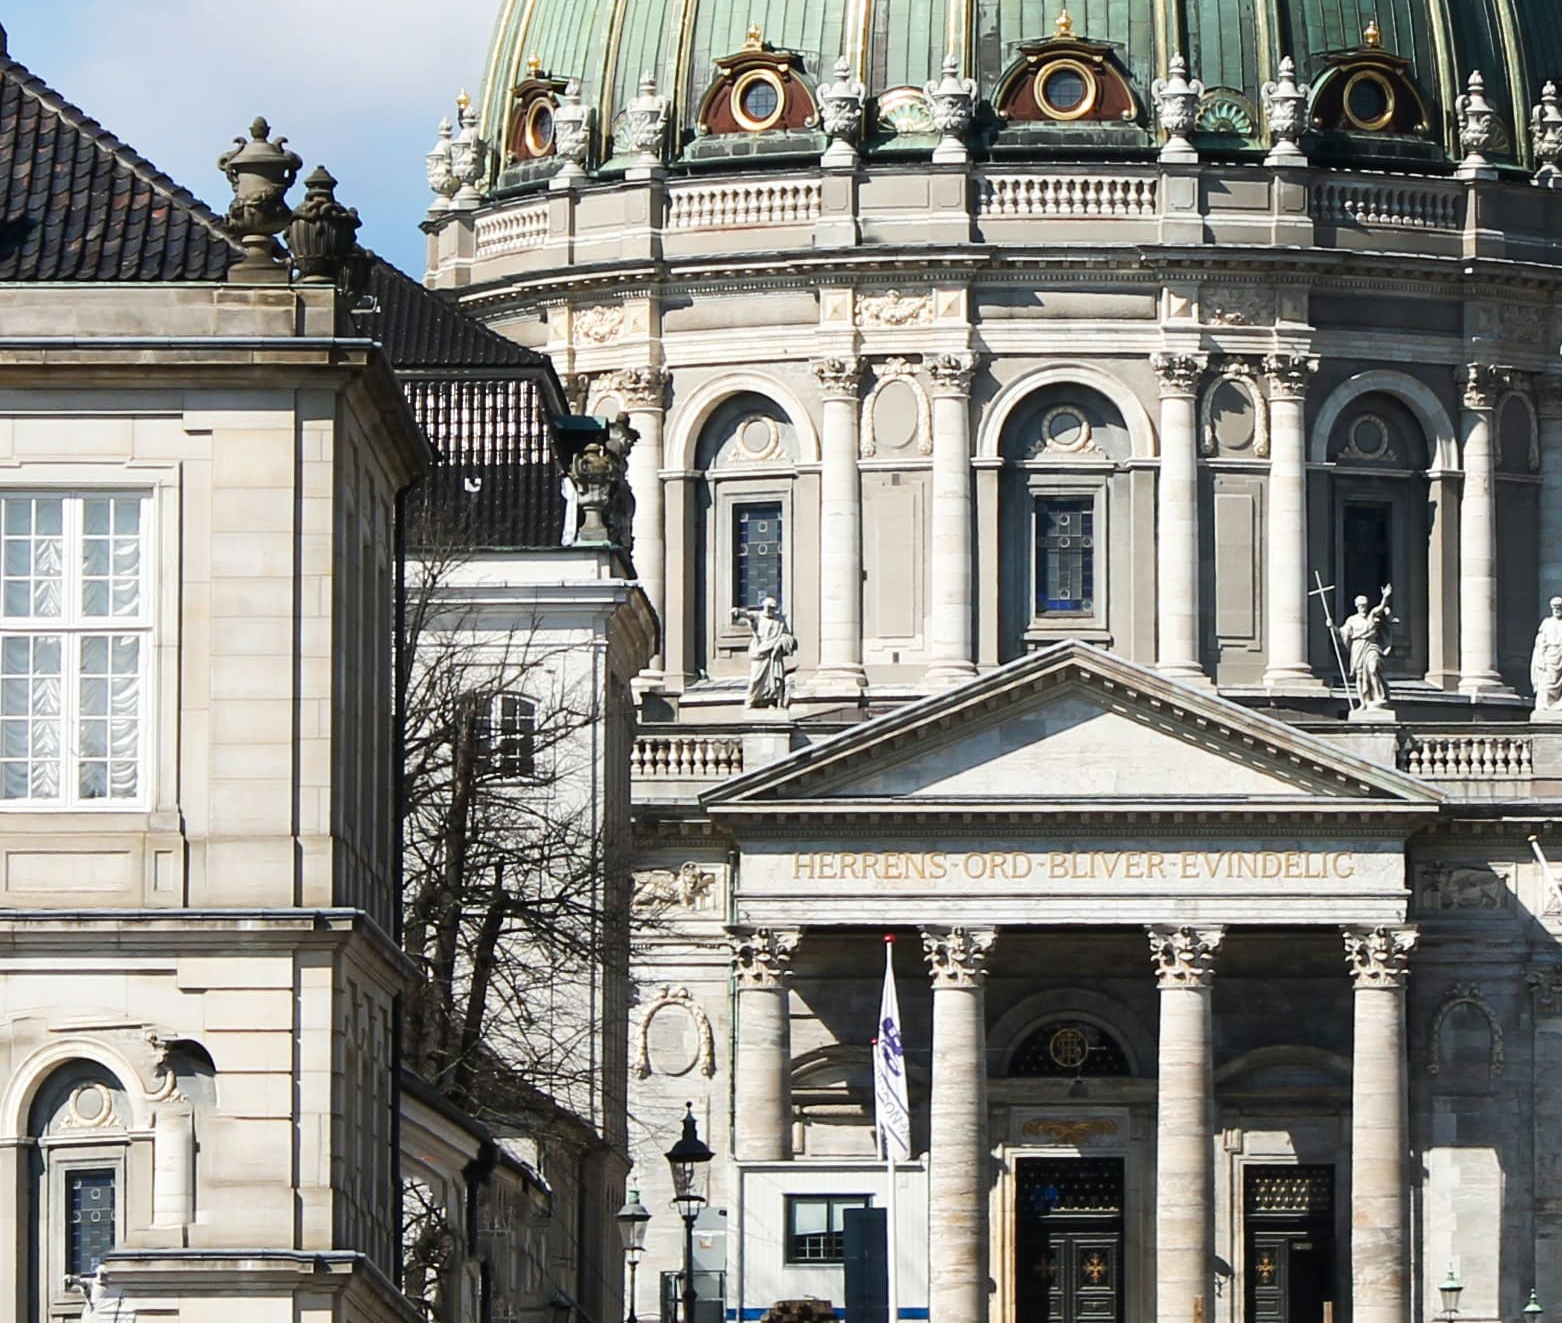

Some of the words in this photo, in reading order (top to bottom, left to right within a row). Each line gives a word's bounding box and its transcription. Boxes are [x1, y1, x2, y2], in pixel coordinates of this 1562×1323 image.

[794, 851, 948, 879] HERRENS
[962, 851, 1033, 879] ORD
[1047, 851, 1166, 879] BLIVER
[1179, 851, 1355, 879] EVINDELIG
